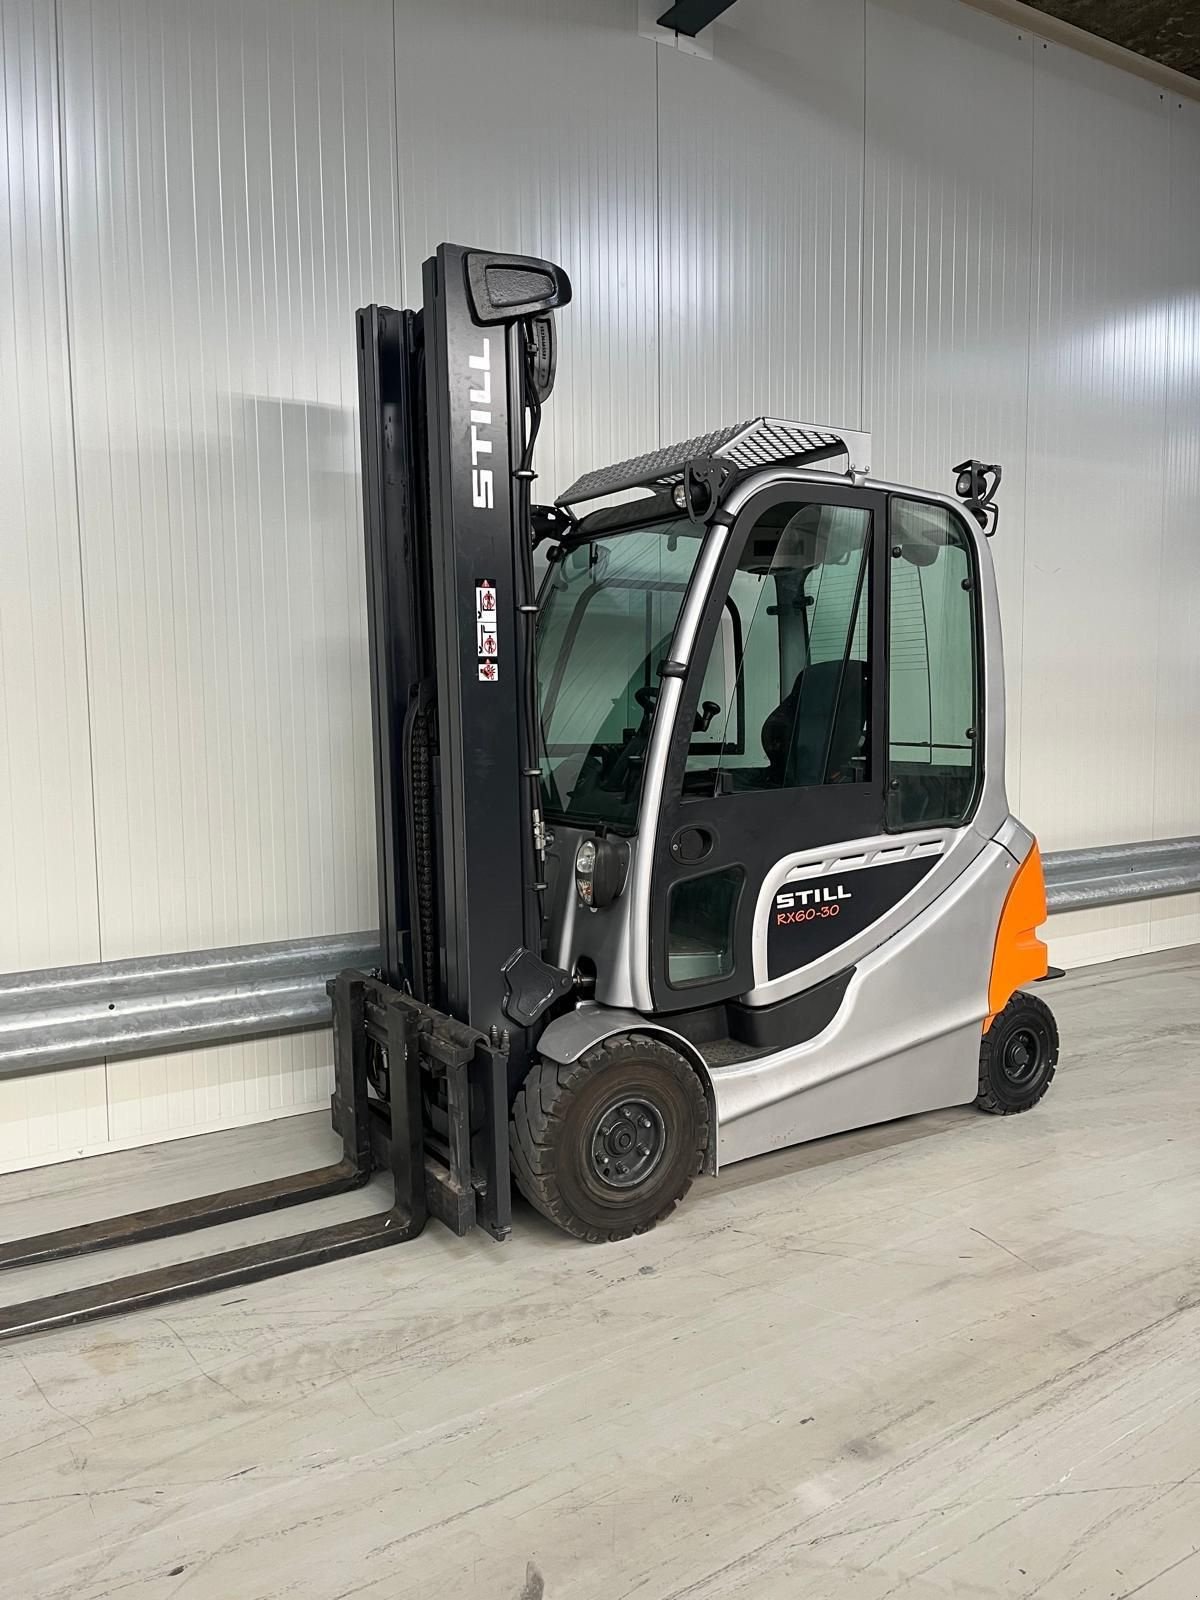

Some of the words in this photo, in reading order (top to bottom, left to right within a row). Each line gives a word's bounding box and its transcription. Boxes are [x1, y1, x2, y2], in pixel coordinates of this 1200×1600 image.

[469, 338, 494, 509] STILL
[776, 885, 852, 909] STILL
[777, 904, 840, 925] RX60-30
